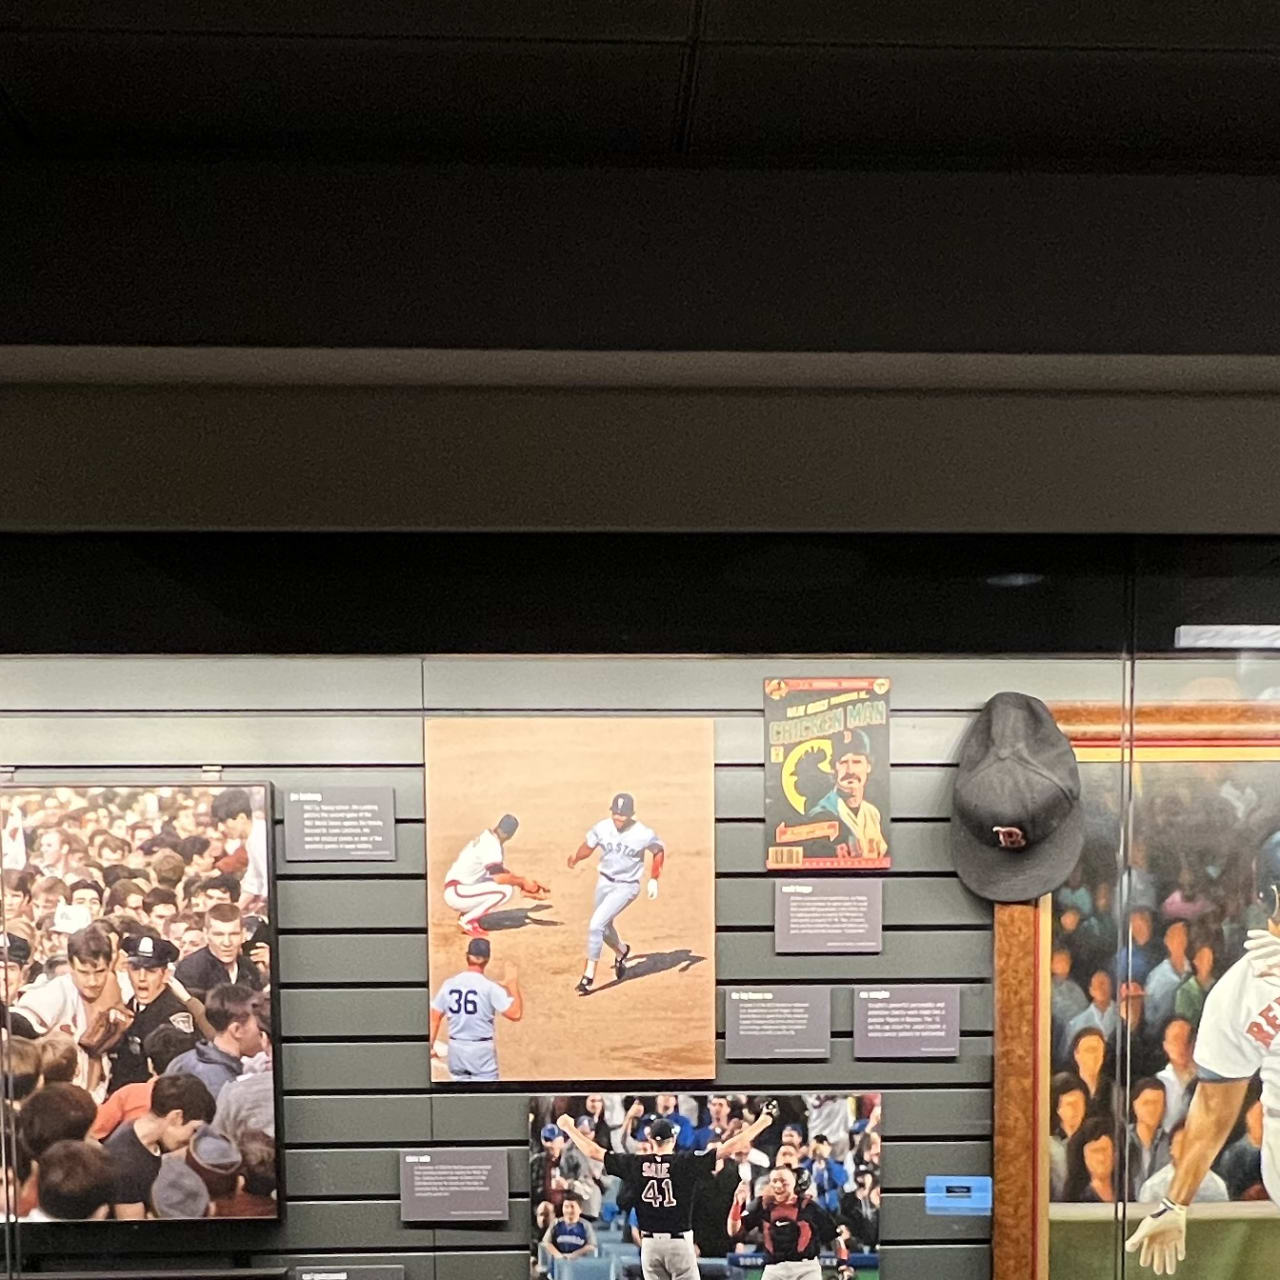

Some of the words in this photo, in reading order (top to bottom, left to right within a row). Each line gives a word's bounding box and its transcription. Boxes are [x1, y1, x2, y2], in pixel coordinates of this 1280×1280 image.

[846, 701, 886, 729] MAN
[993, 826, 1026, 848] B
[448, 989, 478, 1015] 36
[641, 1179, 677, 1208] 41
